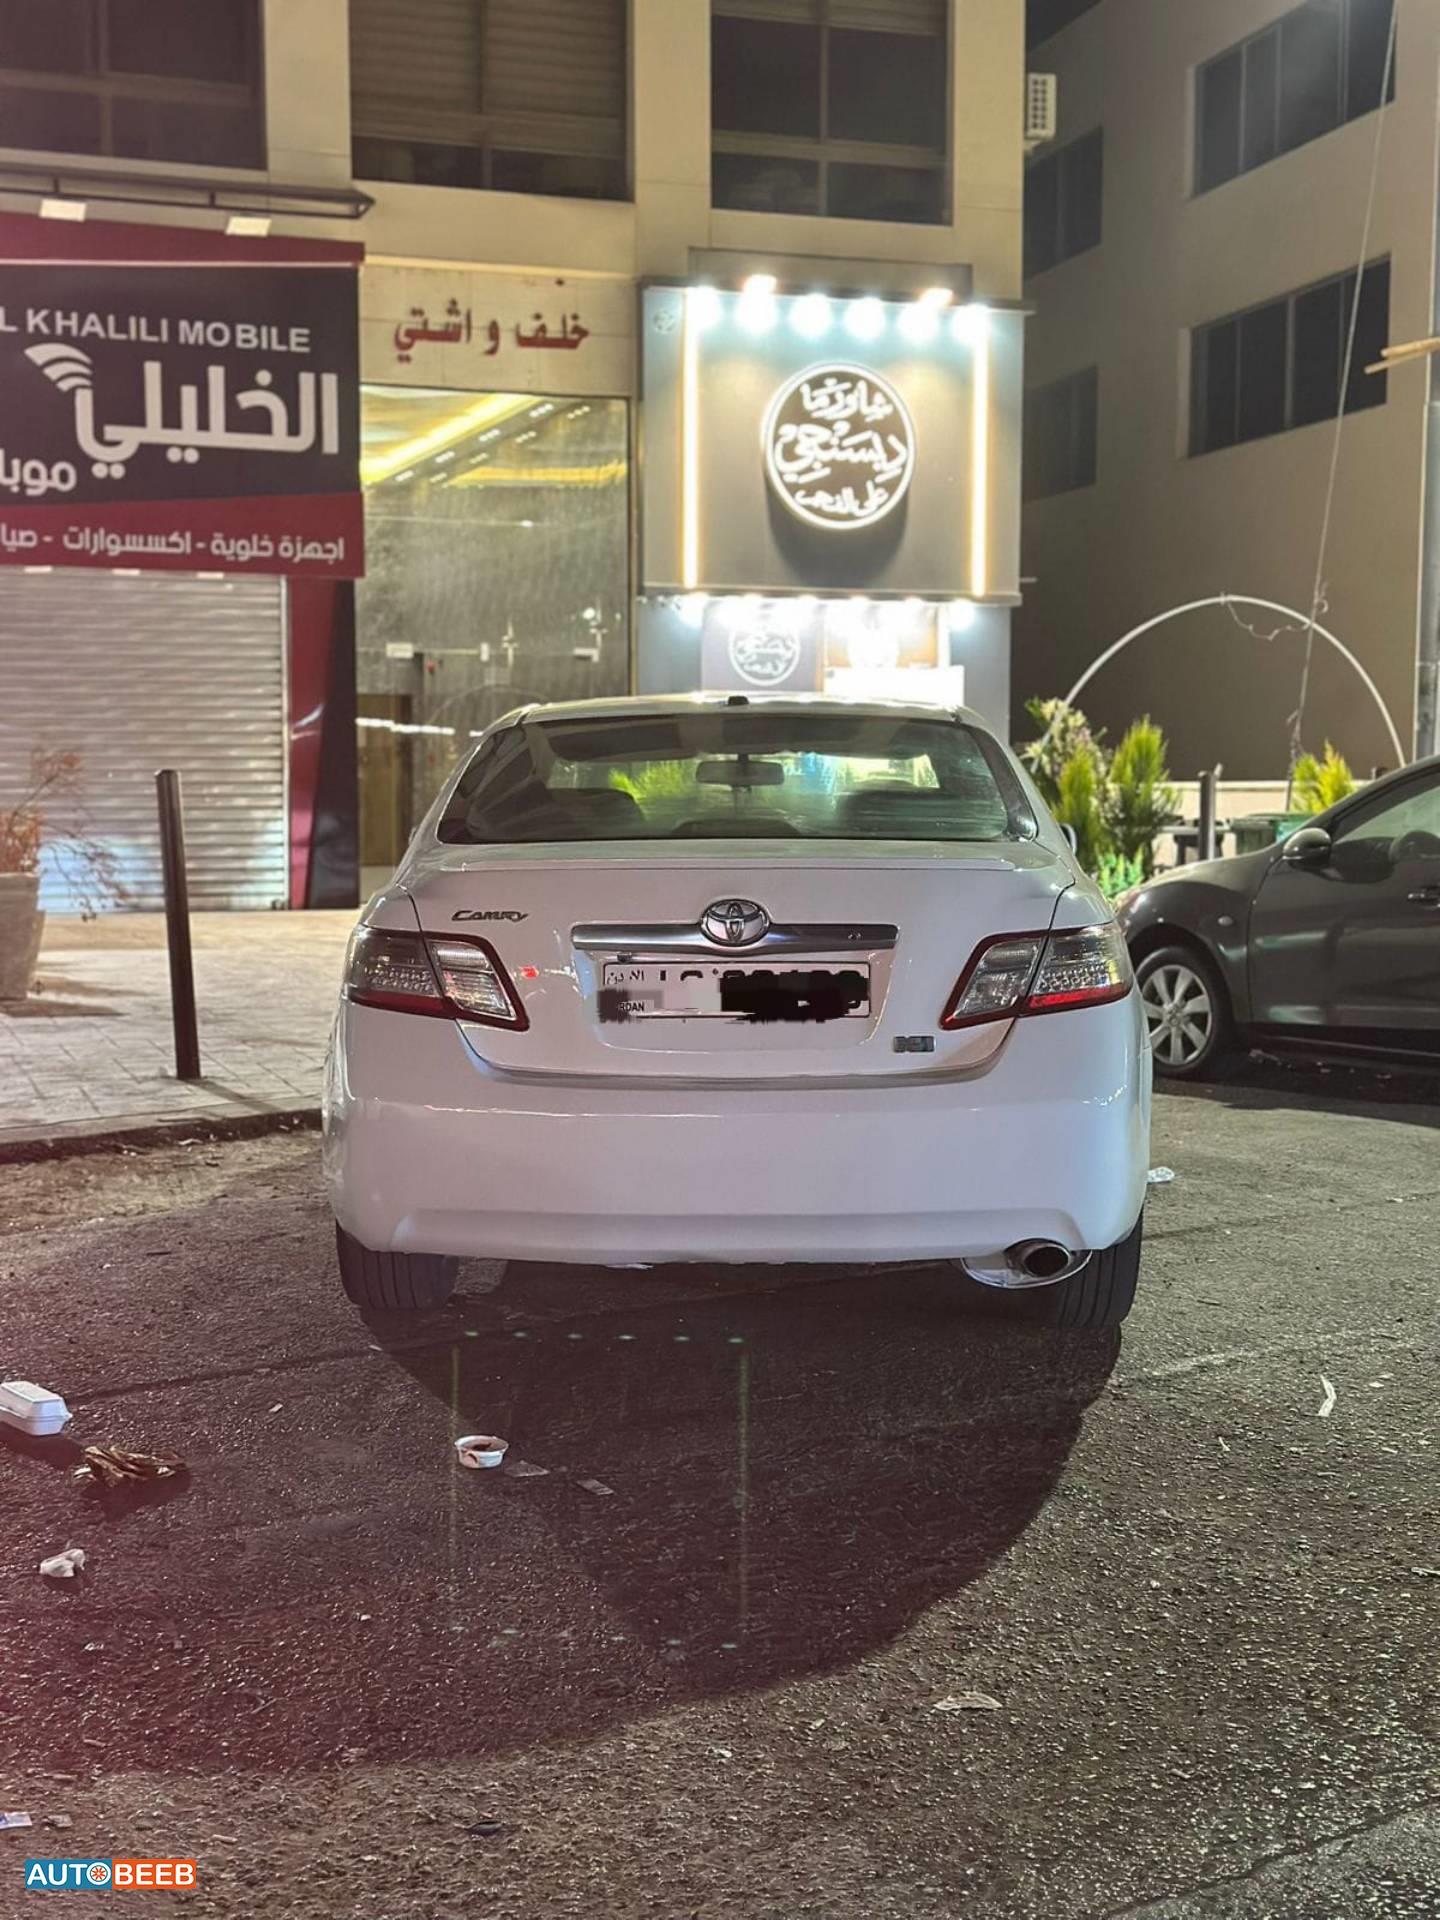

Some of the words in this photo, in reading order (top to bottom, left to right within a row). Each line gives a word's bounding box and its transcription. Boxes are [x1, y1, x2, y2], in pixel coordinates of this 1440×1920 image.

[27, 308, 168, 343] KHALILI
[179, 320, 310, 353] MOBILE
[515, 313, 590, 350] خلف
[75, 360, 338, 480] الخليلي
[63, 526, 192, 556] اكسسوارات
[210, 532, 274, 561] خلوية
[278, 536, 344, 564] اجهزة
